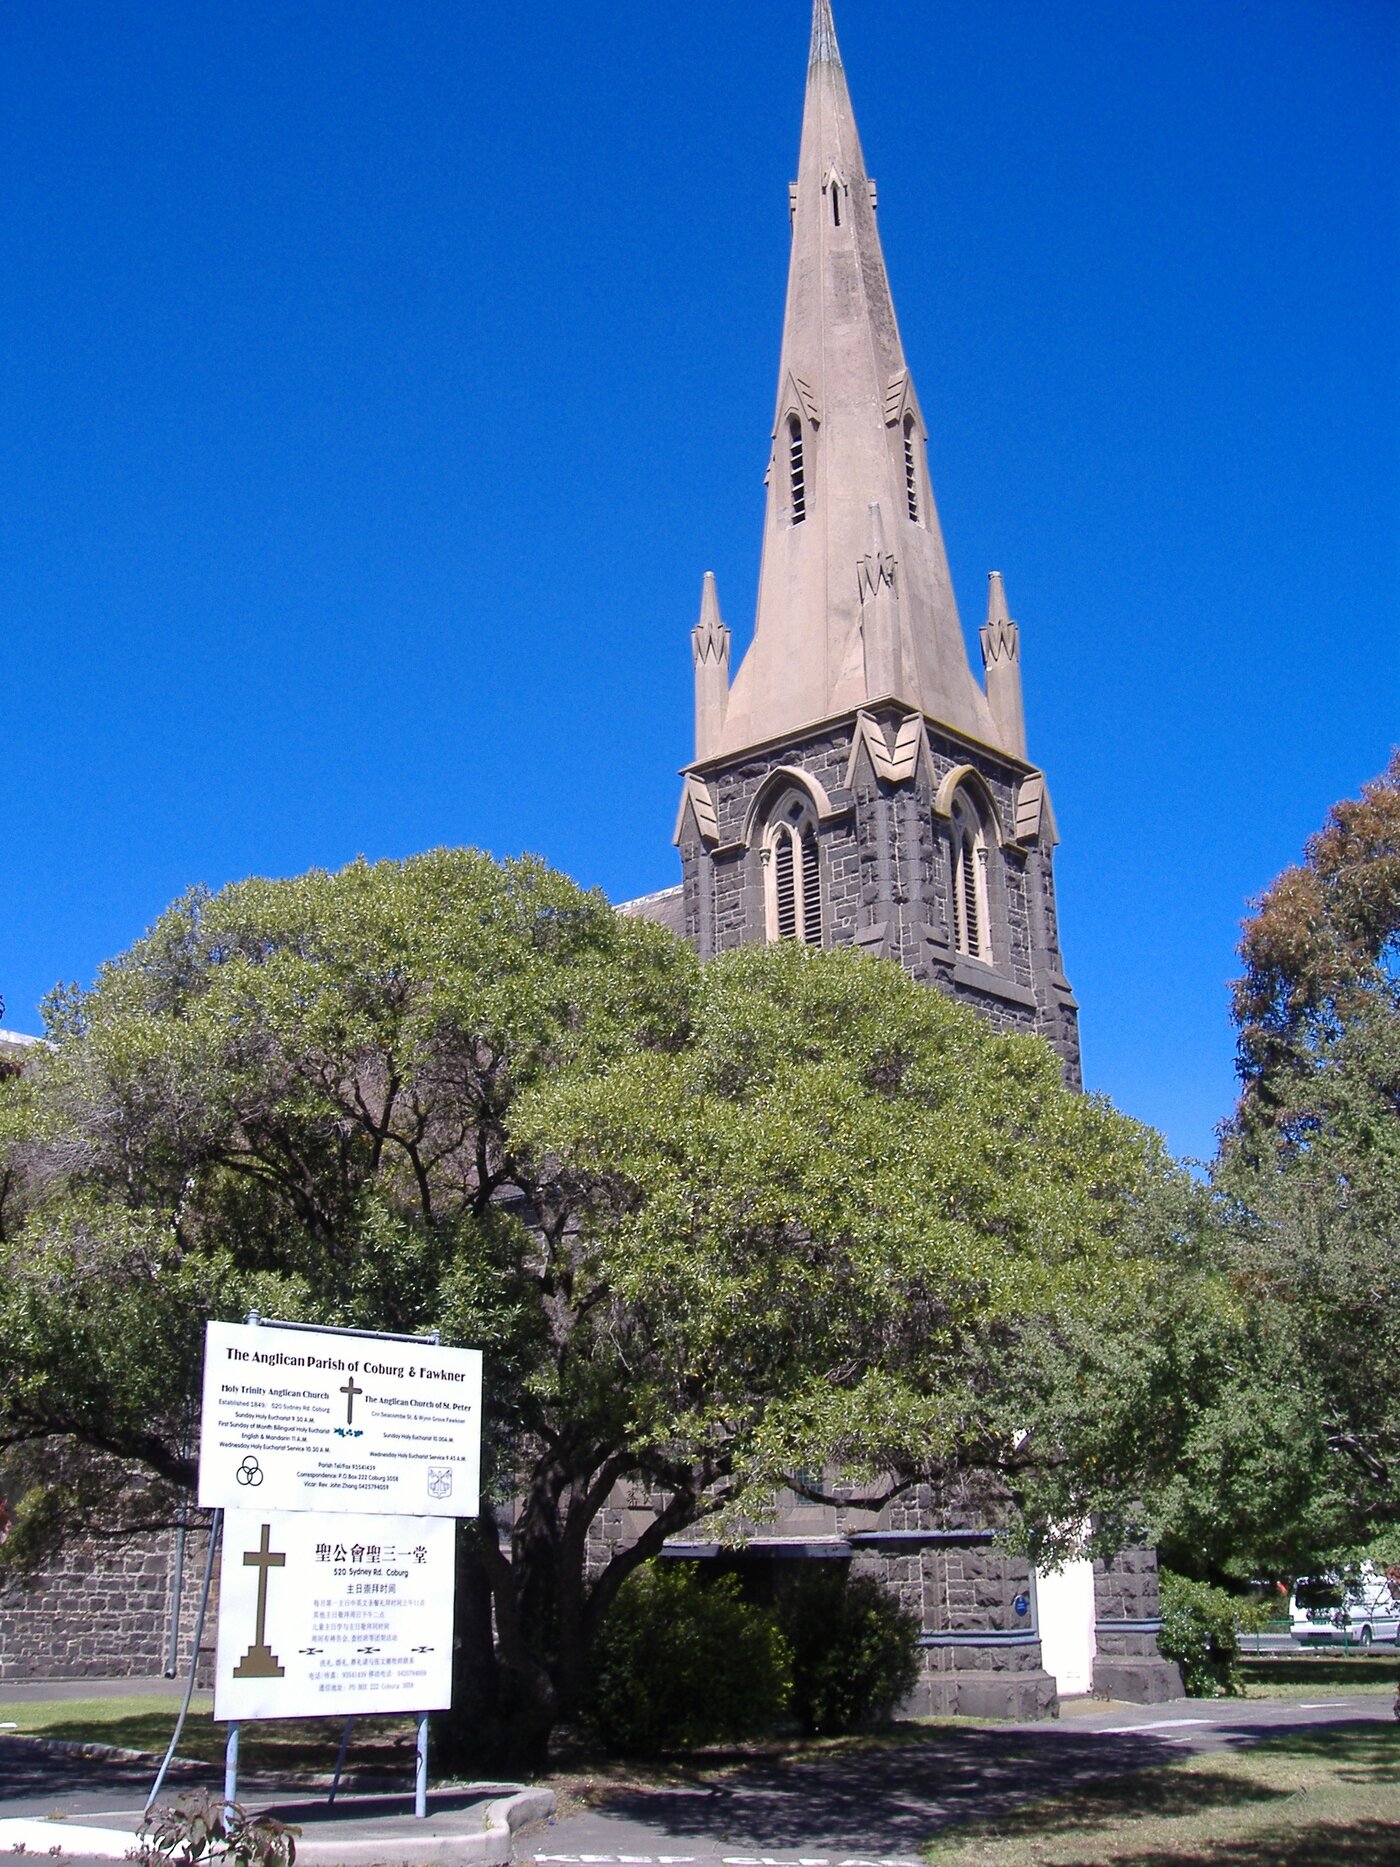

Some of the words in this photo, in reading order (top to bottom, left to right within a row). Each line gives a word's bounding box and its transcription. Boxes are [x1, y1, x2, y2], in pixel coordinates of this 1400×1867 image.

[227, 1348, 249, 1361] The
[252, 1352, 305, 1366] Anglican
[308, 1357, 344, 1370] Parish
[348, 1361, 359, 1372] of
[364, 1362, 404, 1378] Coburg
[409, 1367, 416, 1377] &
[420, 1368, 466, 1382] Fawkner
[222, 1385, 239, 1393] Holy
[241, 1386, 266, 1395] Trinity
[268, 1388, 301, 1397] Anglican
[303, 1391, 329, 1399] Church
[379, 1397, 408, 1406] Anglican
[410, 1400, 434, 1408] Church
[453, 1403, 471, 1411] Peter
[315, 1543, 427, 1563] 聖公會聖三一堂
[349, 1568, 371, 1576] Sydney
[386, 1569, 408, 1578] Coburg
[347, 1584, 396, 1594] 主日崇拜时间
[533, 1854, 695, 1863] KEEP
